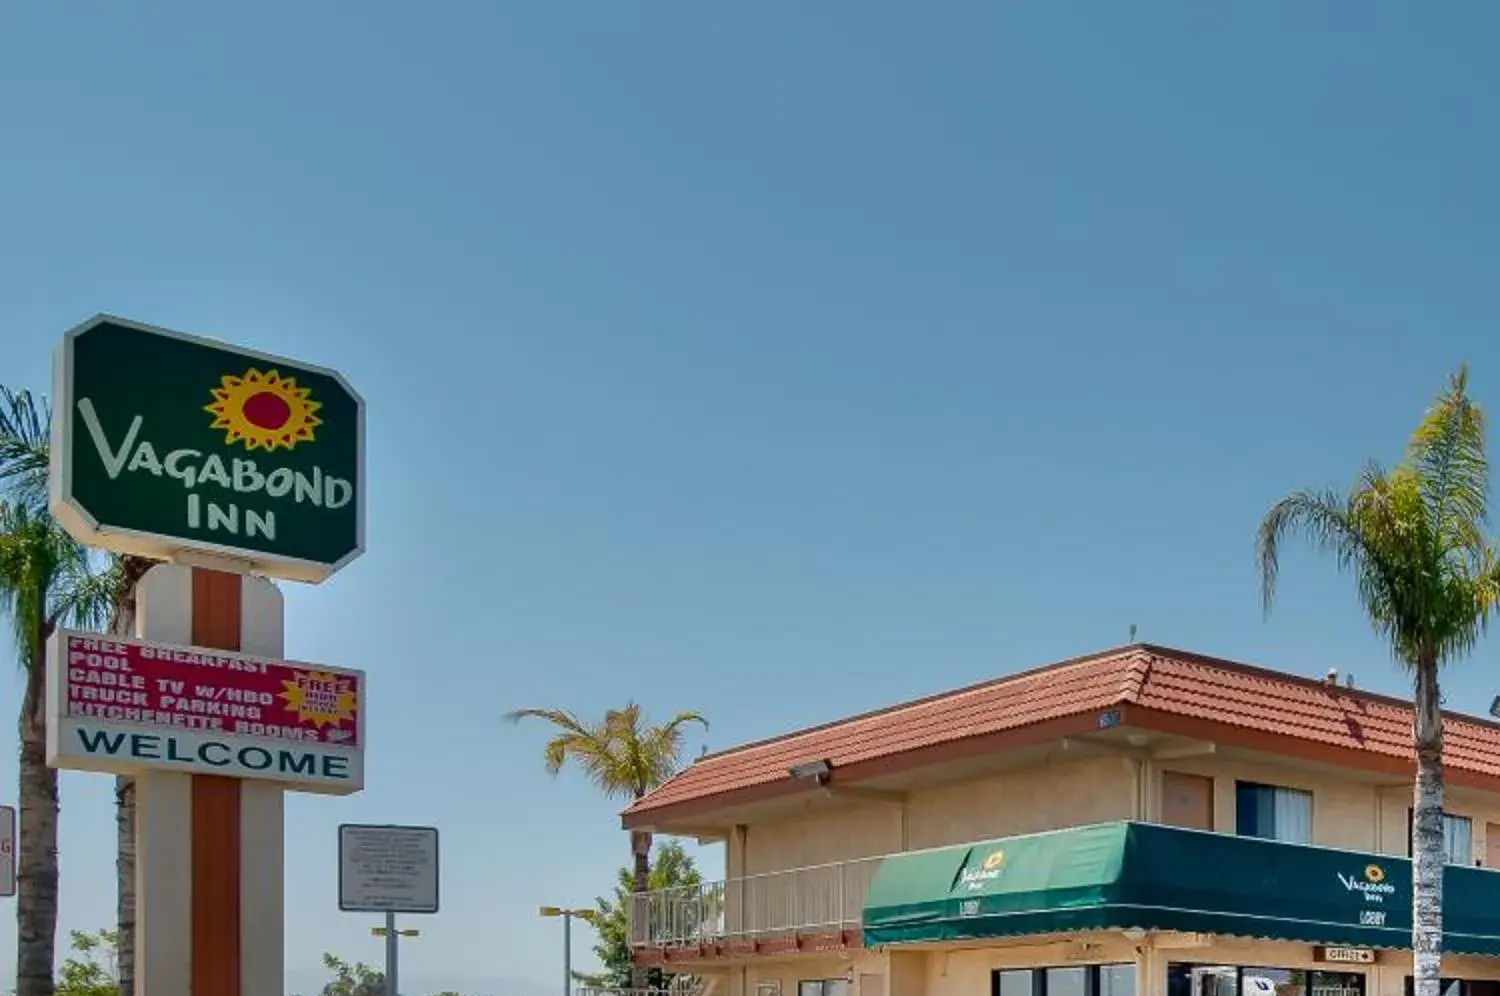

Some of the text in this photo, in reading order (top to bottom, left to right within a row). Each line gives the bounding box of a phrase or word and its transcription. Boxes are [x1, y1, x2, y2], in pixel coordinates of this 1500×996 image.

[78, 398, 352, 508] VAGABOND
[188, 494, 276, 540] INN
[69, 637, 268, 673] FREE BREAKFAST
[69, 651, 134, 671] POOL
[69, 667, 273, 705] CABLE TV W/HBO
[69, 683, 261, 720] TRUCK PARKING
[297, 677, 349, 694] FREE
[69, 701, 222, 729] KITCHENETTE
[235, 720, 320, 741] ROOMS
[77, 728, 349, 778] WELCOME
[1360, 911, 1386, 926] LOBBY
